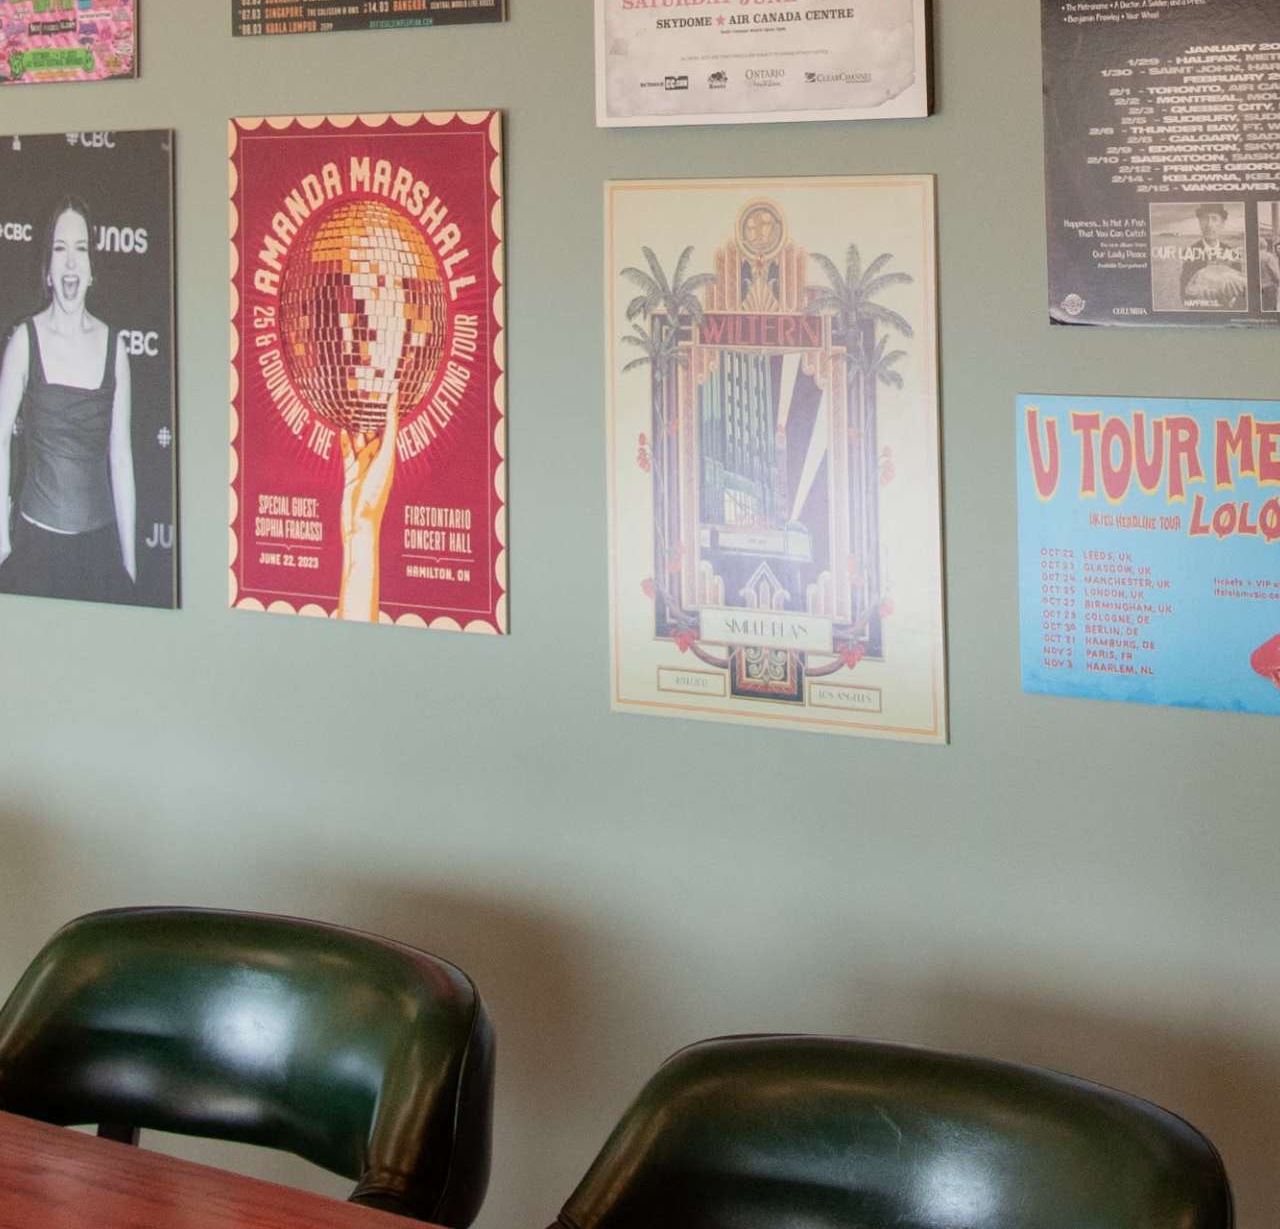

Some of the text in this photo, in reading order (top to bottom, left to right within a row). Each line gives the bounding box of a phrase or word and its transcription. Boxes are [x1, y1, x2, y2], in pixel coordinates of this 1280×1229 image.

[4, 222, 32, 242] CBC
[254, 156, 477, 301] AMANDA MARSHALL
[253, 305, 276, 328] 25
[453, 313, 479, 361] TOUR
[701, 315, 820, 347] WILTERN
[438, 360, 472, 429] LIFTING
[307, 419, 336, 462] THE
[396, 420, 439, 463] HEAVY
[1025, 406, 1061, 500] U
[1069, 409, 1207, 504] TOUR
[404, 505, 472, 530] FIRSTONTARIO
[403, 527, 472, 554] CONCERT HALL
